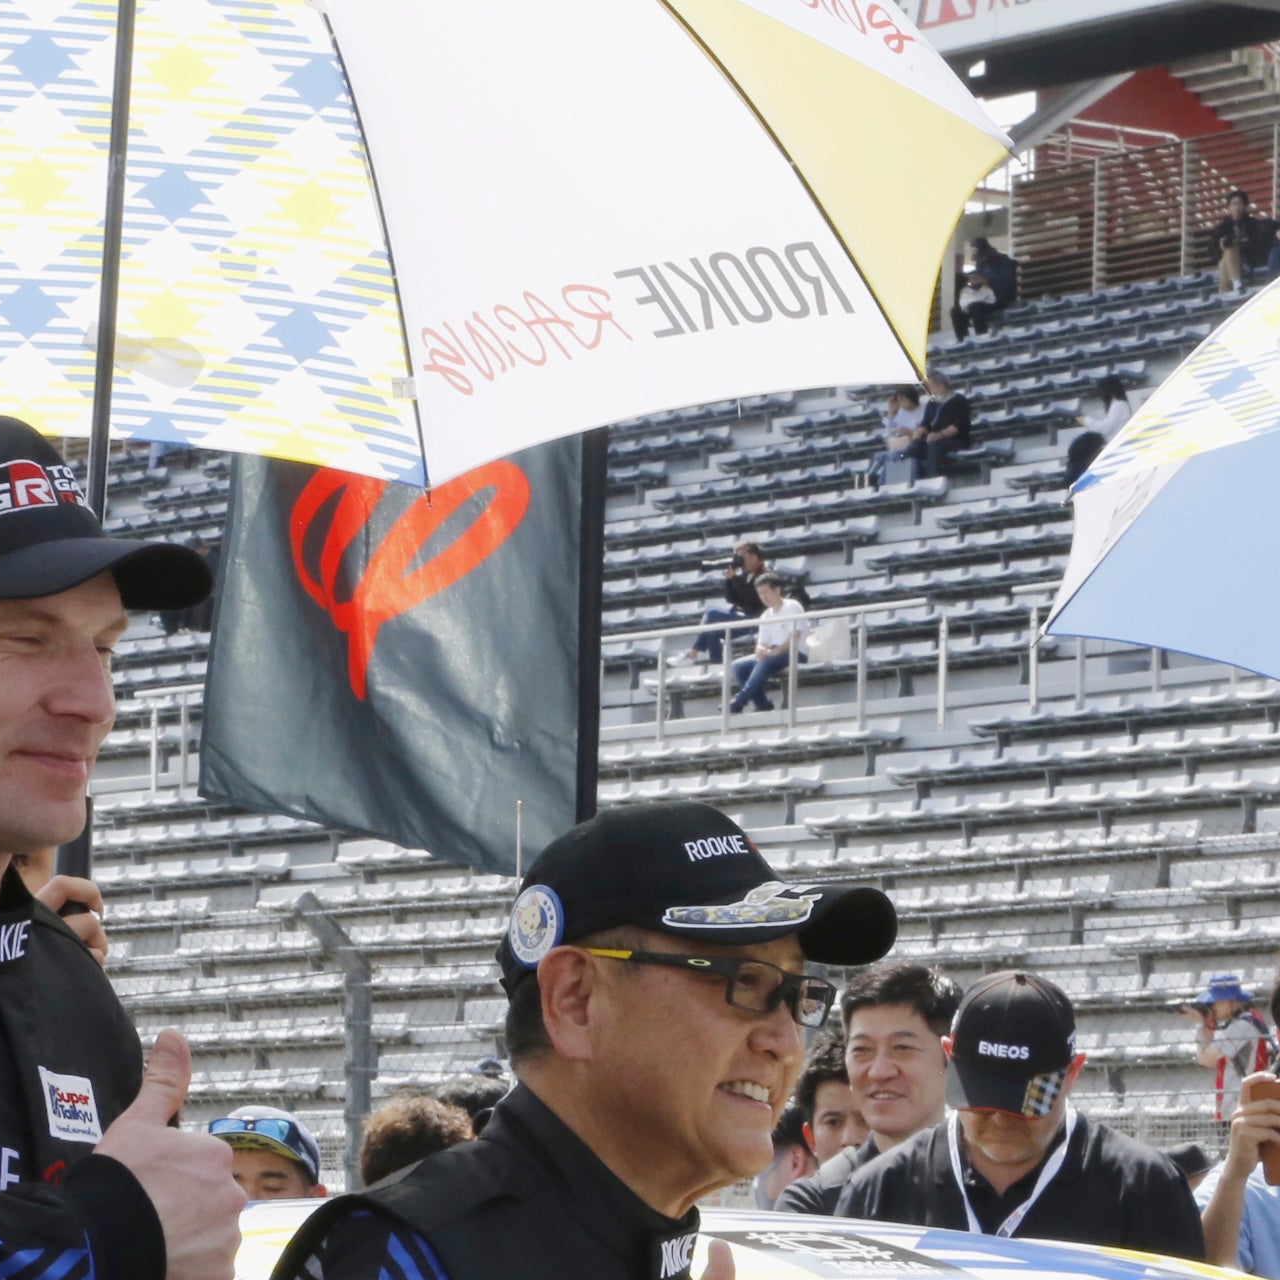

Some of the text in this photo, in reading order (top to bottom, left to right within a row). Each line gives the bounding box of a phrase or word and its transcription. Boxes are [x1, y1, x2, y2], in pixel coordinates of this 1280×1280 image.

[685, 834, 749, 863] ROOKIE
[978, 1040, 1030, 1061] ENEOS
[55, 1087, 90, 1105] Super
